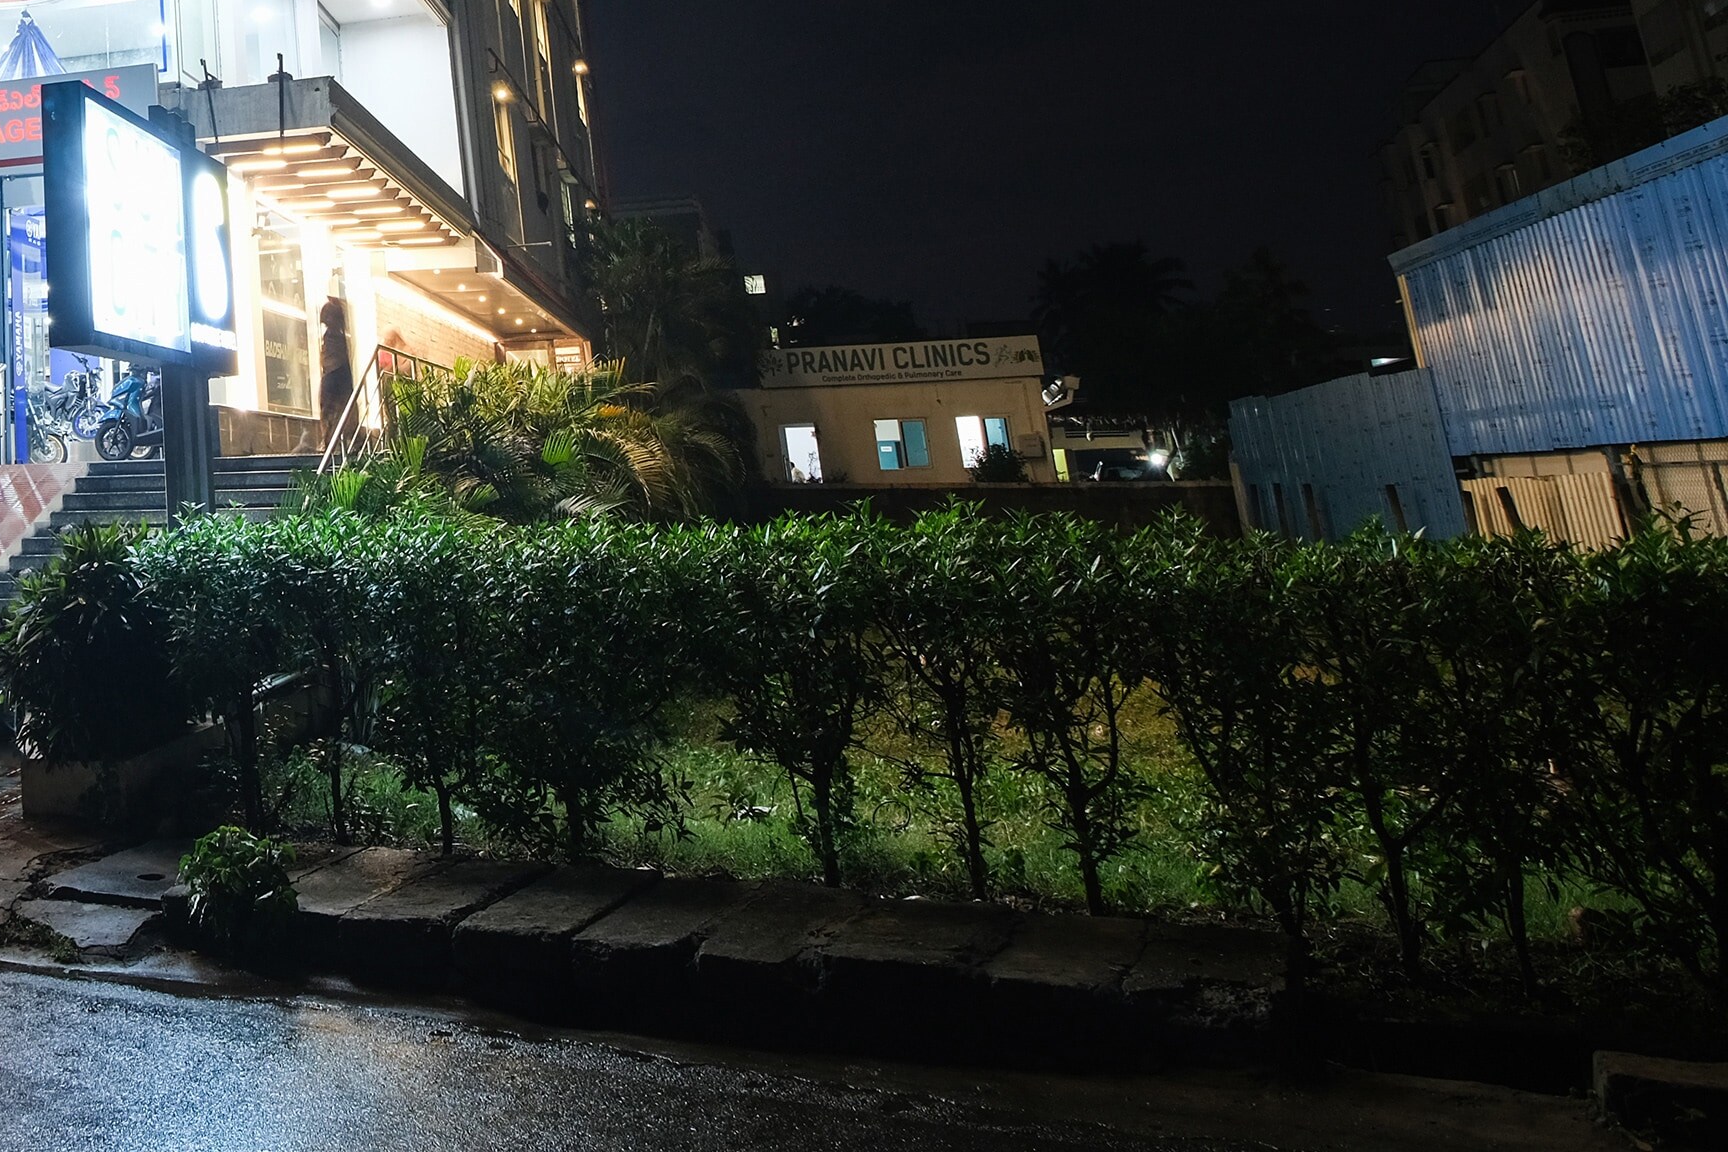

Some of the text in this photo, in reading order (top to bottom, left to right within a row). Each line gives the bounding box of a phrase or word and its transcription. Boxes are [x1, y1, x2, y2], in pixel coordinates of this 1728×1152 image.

[15, 311, 23, 361] YAMAHA
[786, 342, 990, 375] PRANAVI CLINICS
[822, 373, 856, 383] Complete
[857, 372, 896, 381] Orthopedic
[904, 370, 944, 380] Pulmonary
[945, 369, 962, 377] Care
